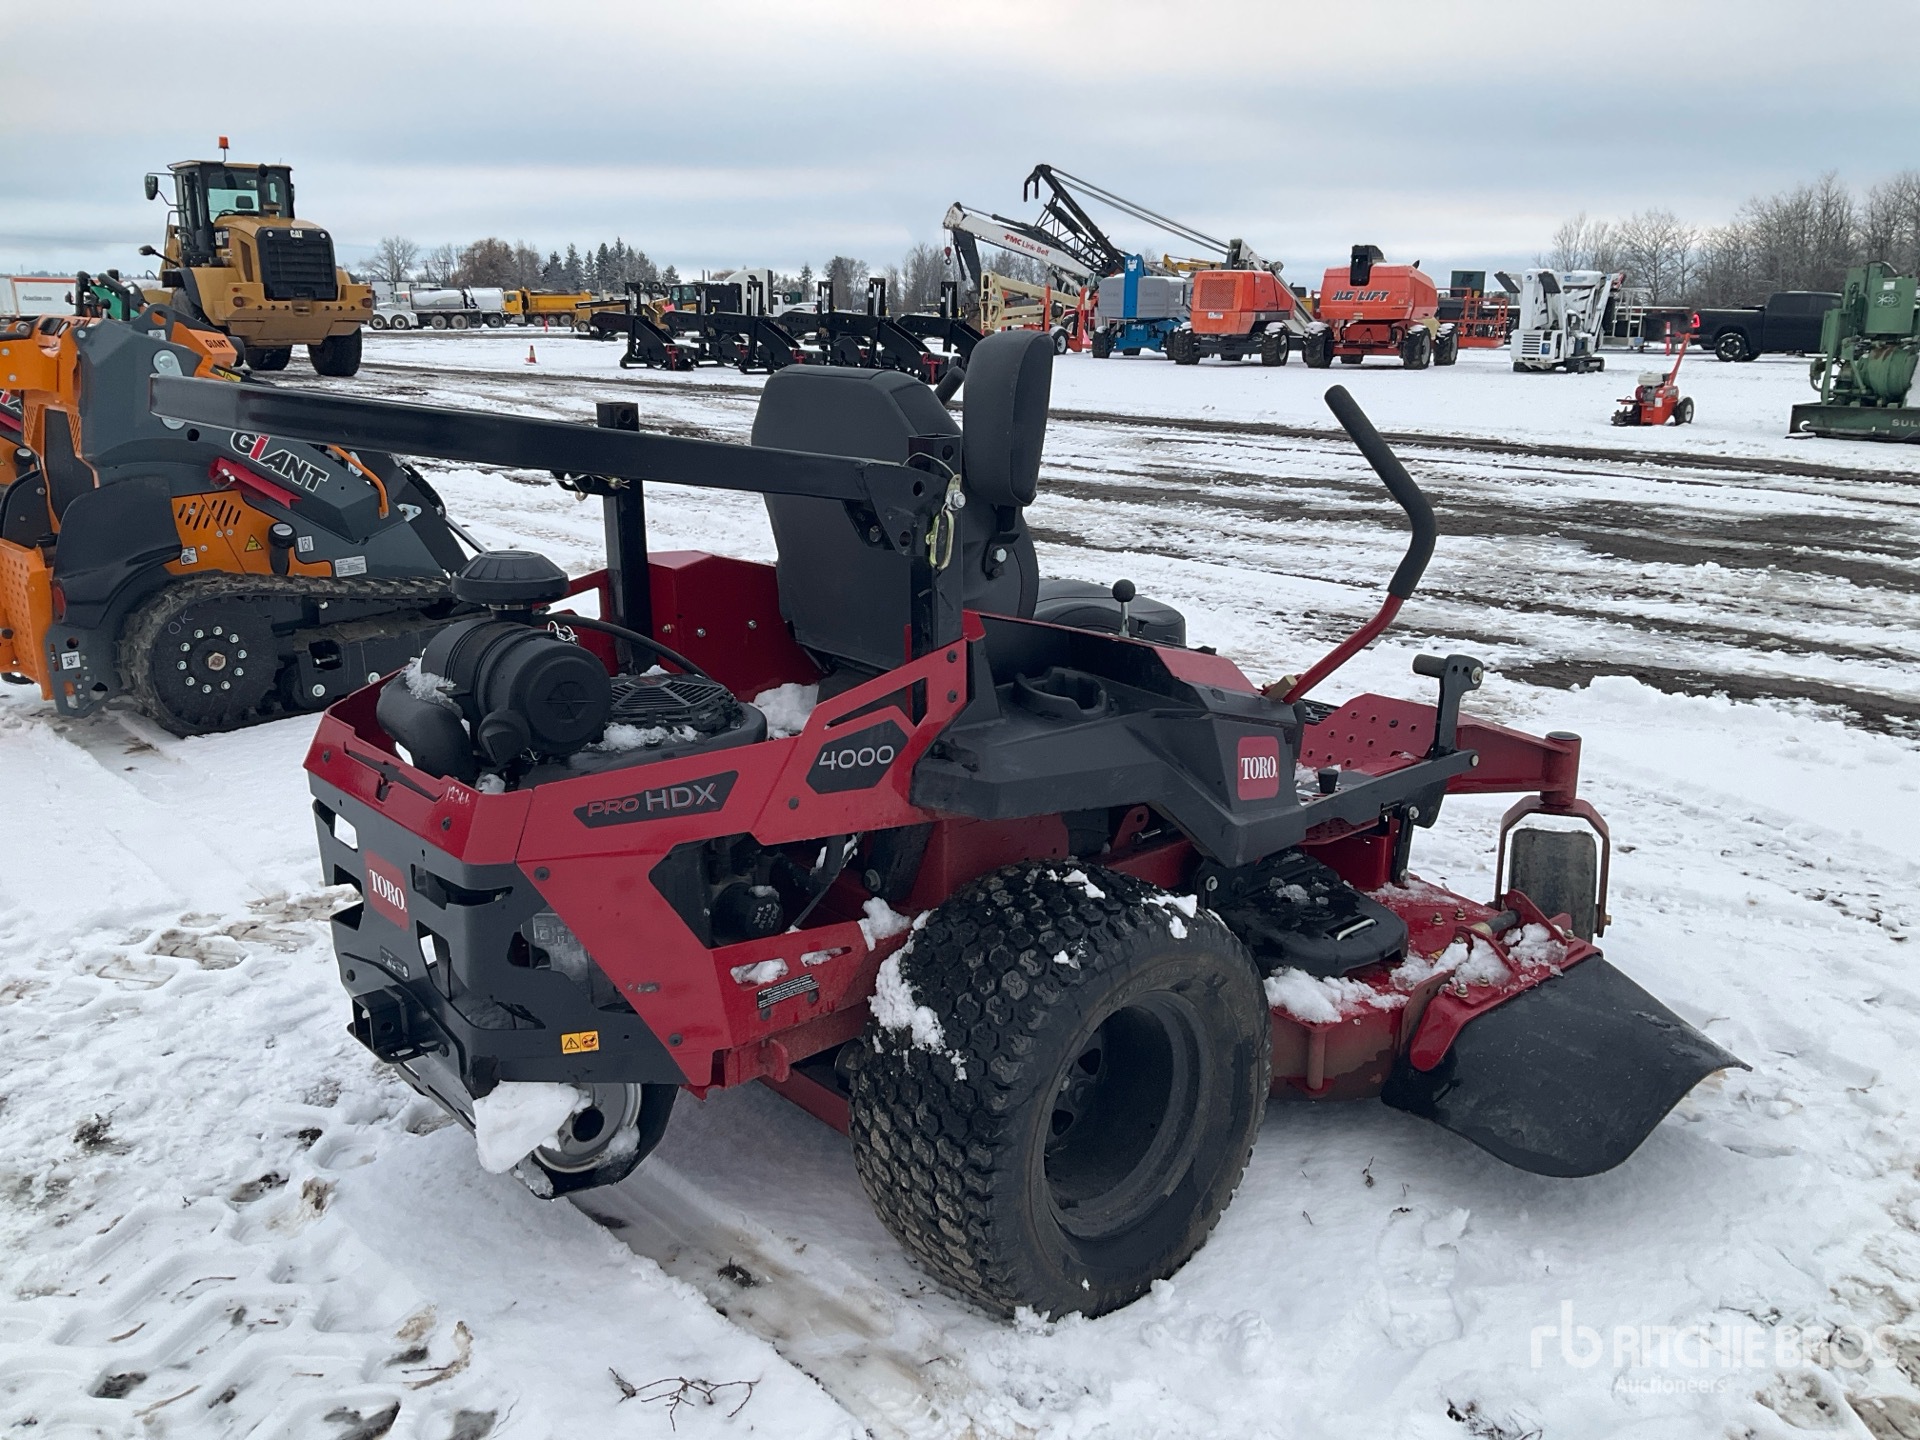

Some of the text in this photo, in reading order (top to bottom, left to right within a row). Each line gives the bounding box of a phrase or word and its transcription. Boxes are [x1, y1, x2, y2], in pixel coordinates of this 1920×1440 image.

[290, 230, 303, 238] CAT
[1004, 234, 1022, 246] FMC
[1331, 290, 1390, 302] JLG LIFT
[205, 339, 229, 349] GIANT
[1891, 418, 1920, 428] SUL
[168, 609, 194, 635] OK
[819, 745, 894, 770] 4000
[1240, 755, 1277, 780] TORO
[587, 782, 719, 817] PRO HDX
[369, 868, 407, 912] TORO
